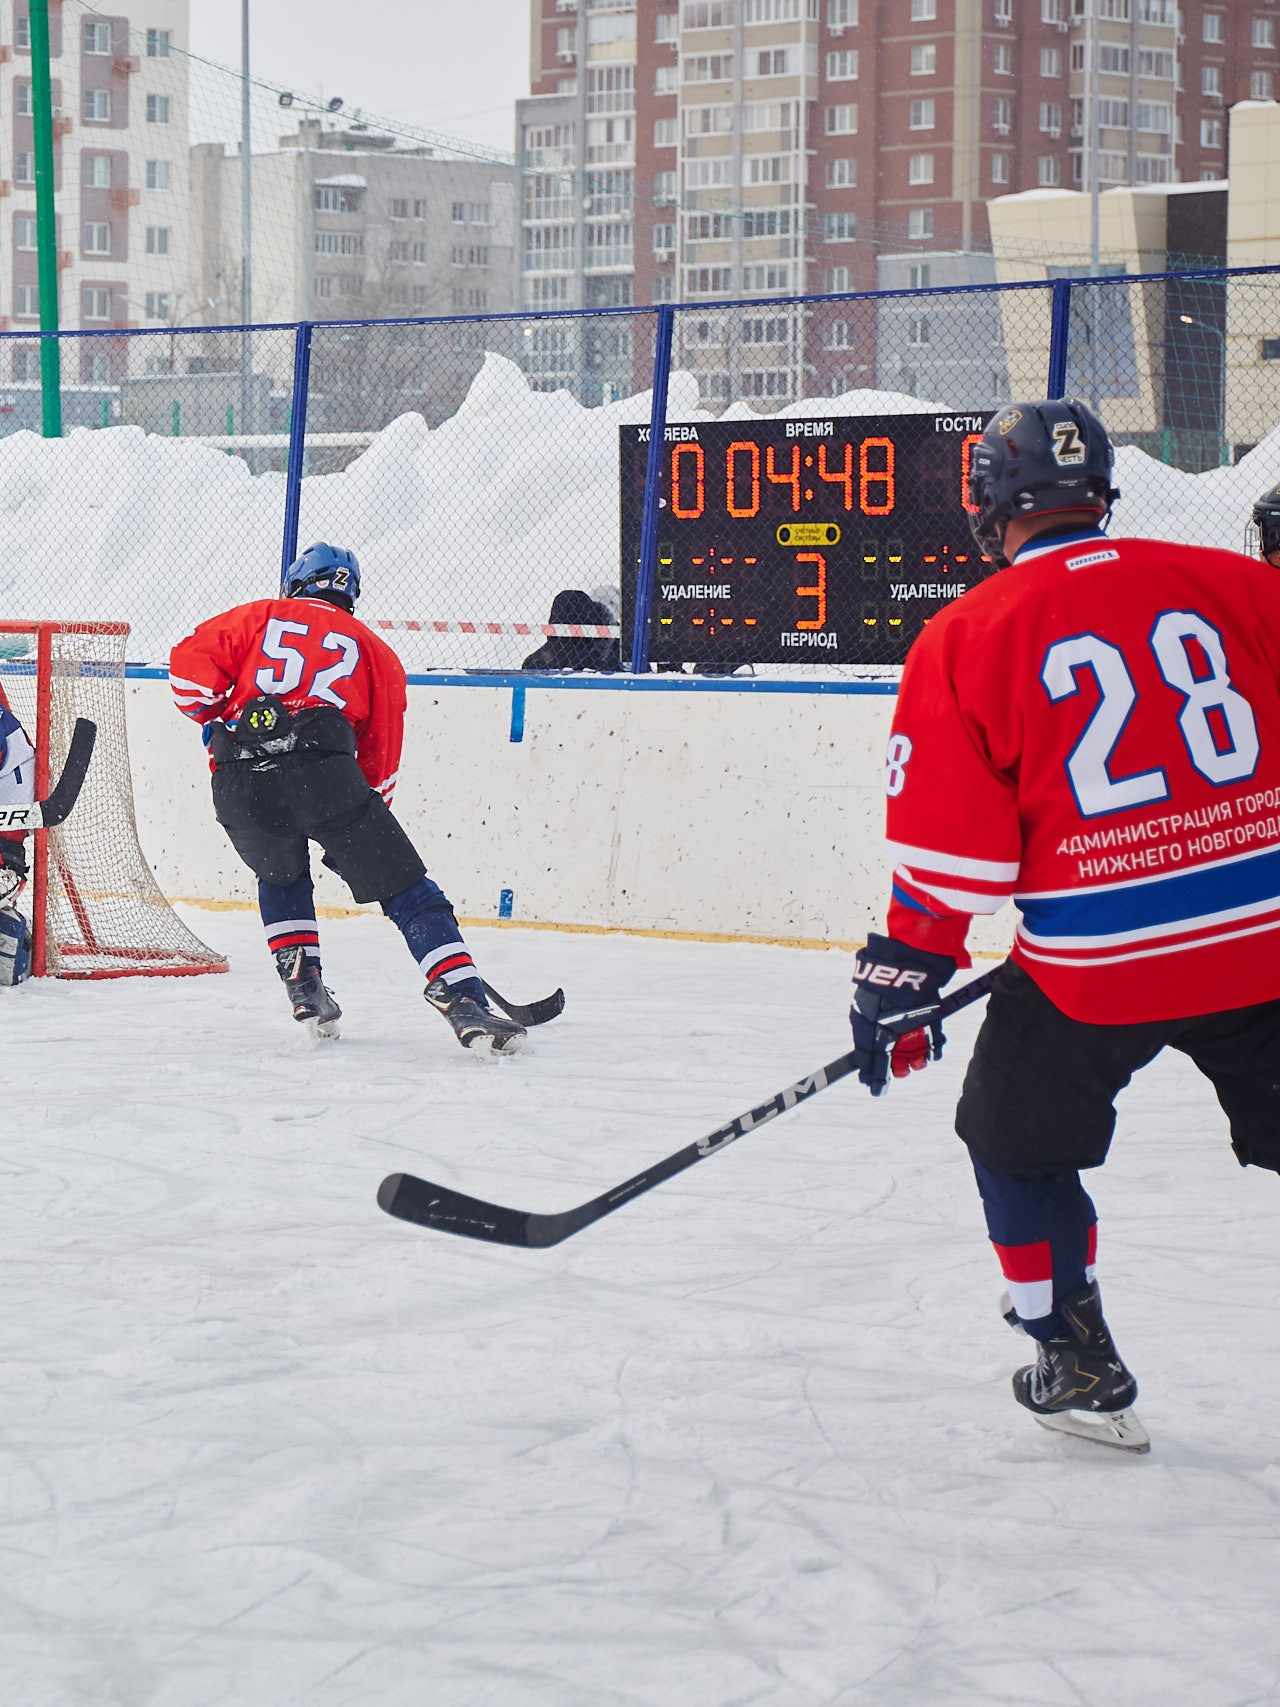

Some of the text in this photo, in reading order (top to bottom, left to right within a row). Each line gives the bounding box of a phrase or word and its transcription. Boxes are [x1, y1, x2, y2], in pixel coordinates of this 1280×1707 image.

[638, 427, 699, 442] ХЯЕВА
[785, 422, 834, 437] ВРЕМЯ
[935, 416, 982, 432] ГОСТИ
[1055, 429, 1082, 456] Z
[671, 443, 705, 519] 0
[726, 436, 896, 518] 04:48
[661, 584, 731, 600] УДАЛЕНИЕ
[796, 552, 827, 630] 3
[890, 583, 966, 601] УДАЛЕНИЕ
[254, 617, 360, 709] 52
[781, 632, 838, 649] ПЕРИОД
[1039, 608, 1261, 821] 28
[886, 732, 914, 798] 8
[1056, 801, 1232, 856] АДМИНИСТРАЦИЯ
[1078, 815, 1280, 878] НИЖНЕГО НОВГОРОД
[696, 1066, 829, 1157] CCM
